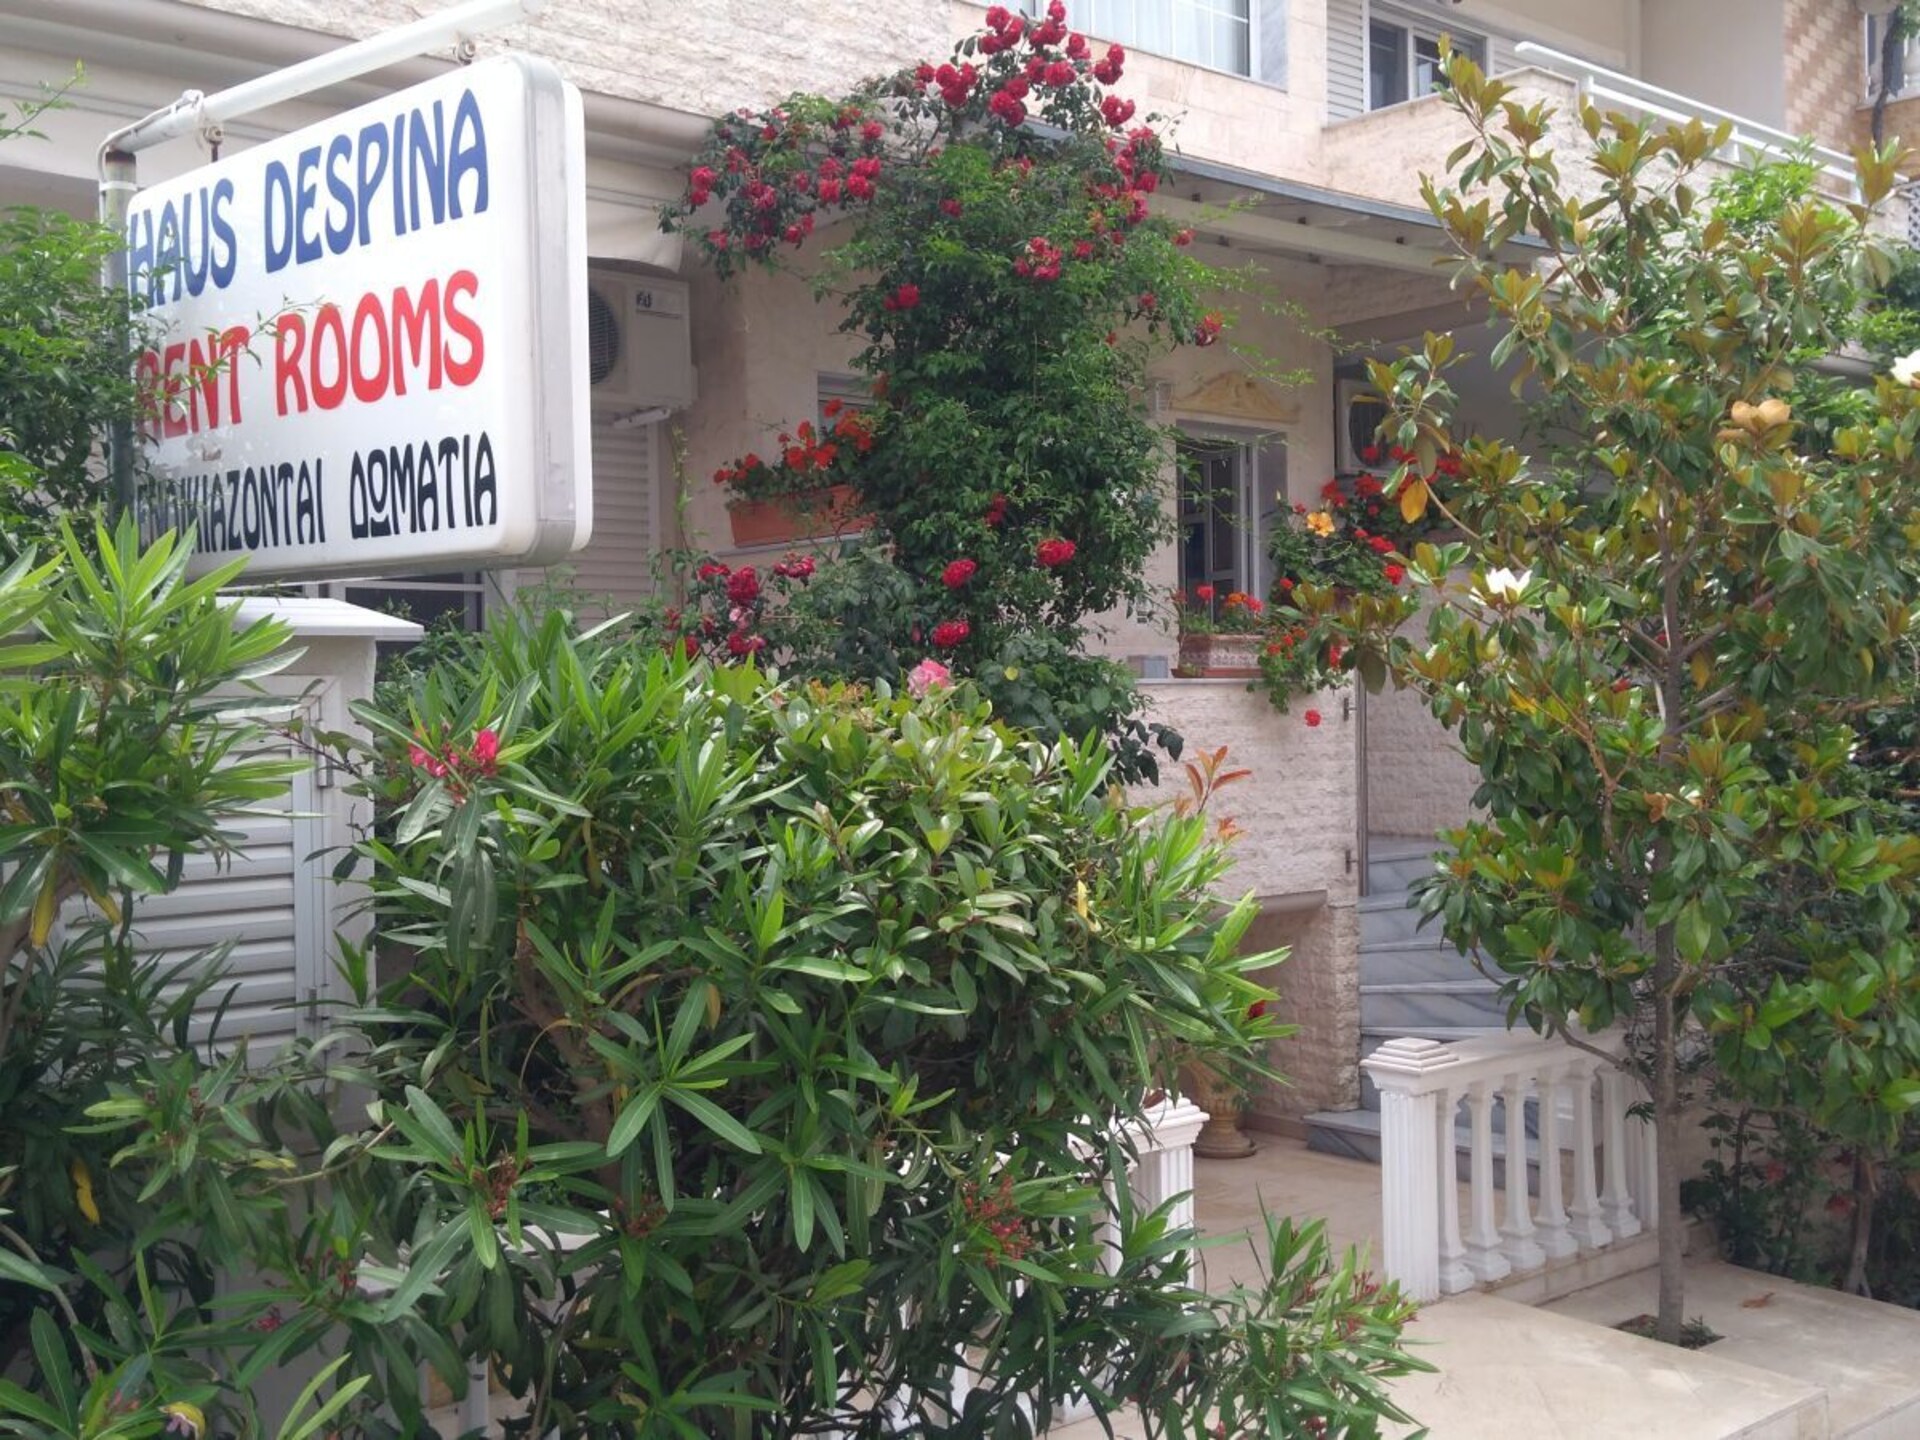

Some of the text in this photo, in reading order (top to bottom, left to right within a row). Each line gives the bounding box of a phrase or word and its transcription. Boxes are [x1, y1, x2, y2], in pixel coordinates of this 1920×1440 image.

[129, 88, 489, 308] HAUS DESPINA
[135, 269, 484, 440] RENT ROOMS
